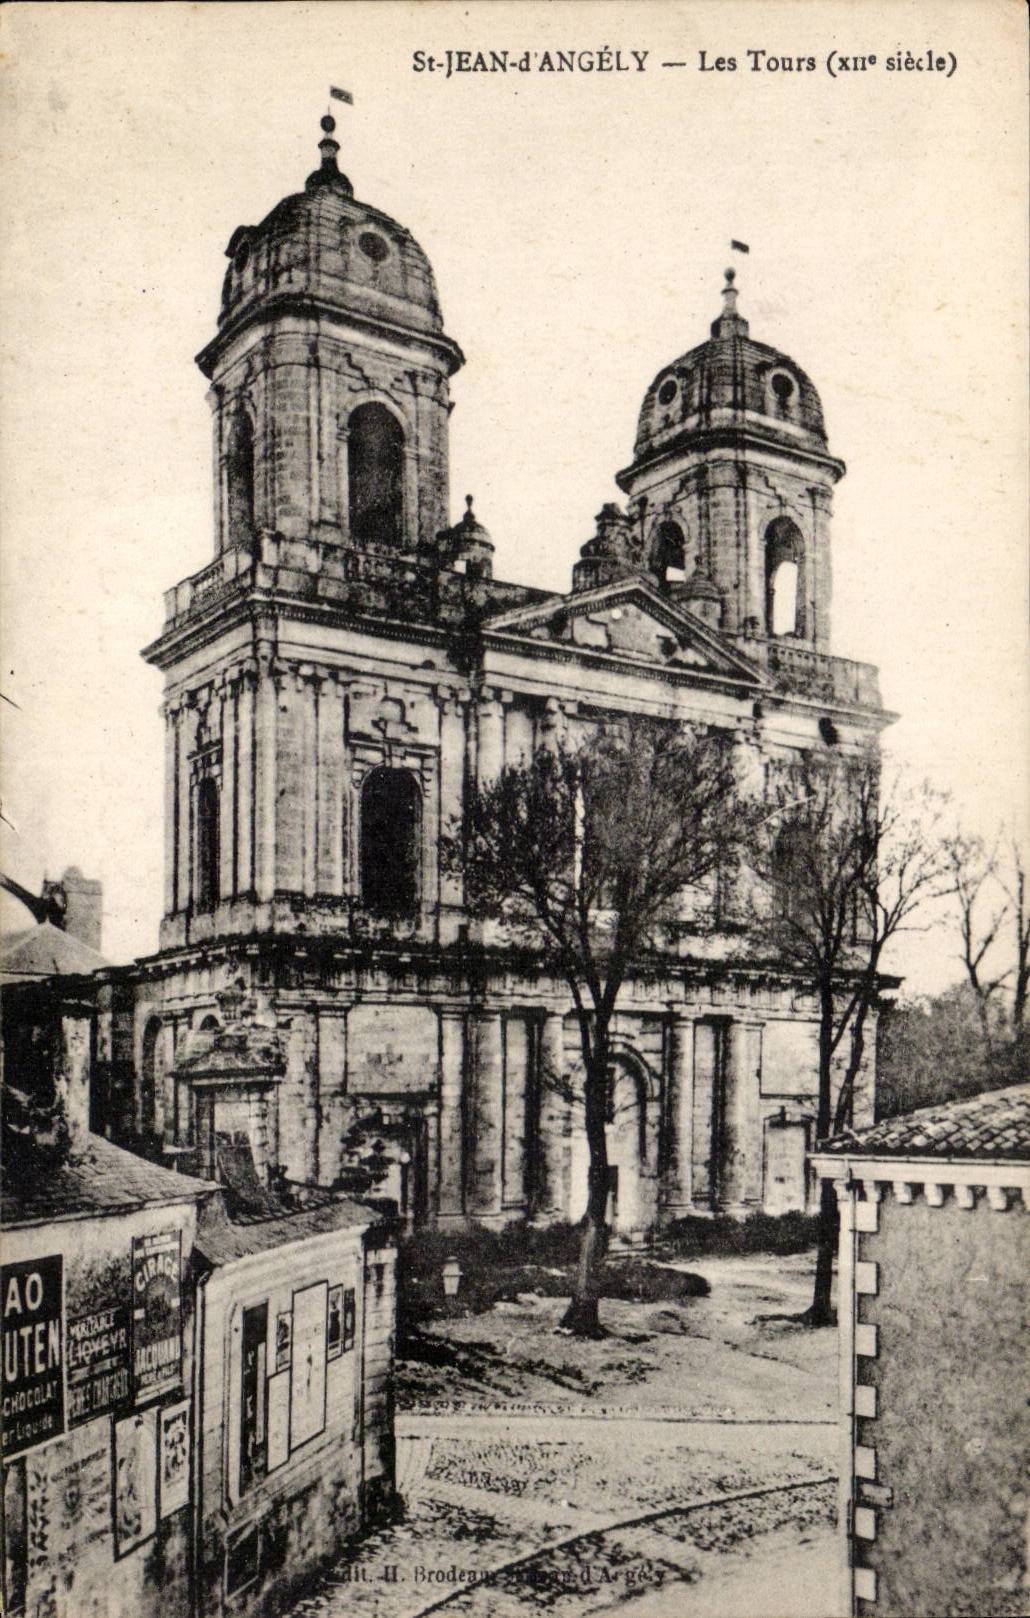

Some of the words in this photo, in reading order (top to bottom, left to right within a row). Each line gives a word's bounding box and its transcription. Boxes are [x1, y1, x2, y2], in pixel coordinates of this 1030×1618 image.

[4, 1271, 44, 1318] AO
[3, 1318, 61, 1383] UTEN
[2, 1379, 58, 1417] CHOCOLAT
